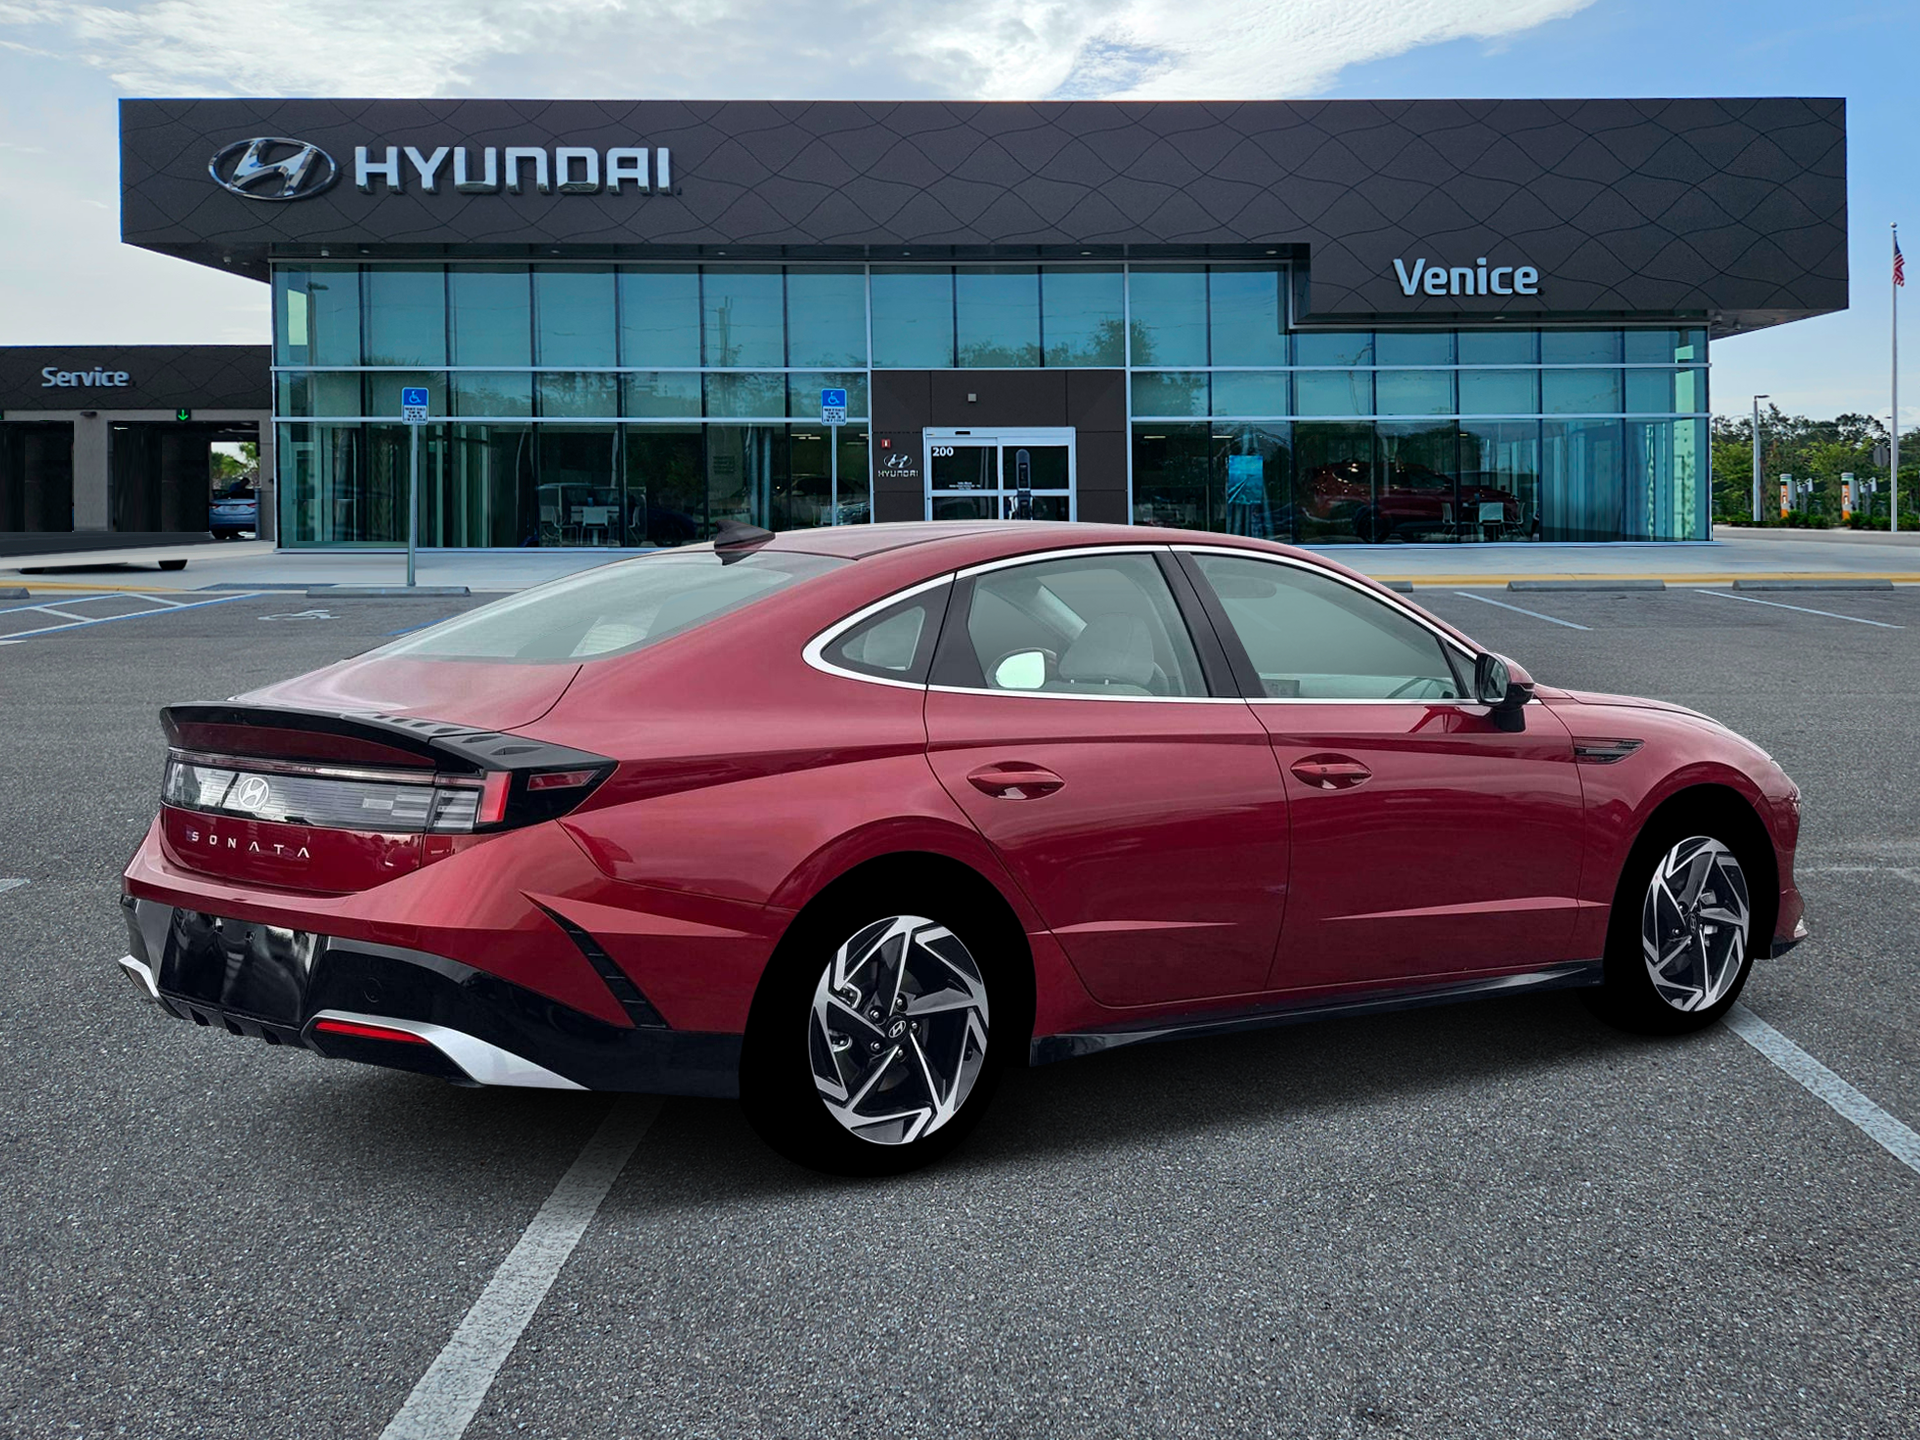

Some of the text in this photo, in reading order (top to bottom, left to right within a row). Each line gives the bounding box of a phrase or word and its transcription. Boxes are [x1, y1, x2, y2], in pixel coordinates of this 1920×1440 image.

[354, 146, 671, 194] HYUNDAI
[1392, 257, 1539, 296] Venice
[41, 366, 130, 387] Service
[932, 447, 954, 457] 200
[877, 470, 919, 478] HYUNDAI
[191, 831, 310, 859] SONATA
